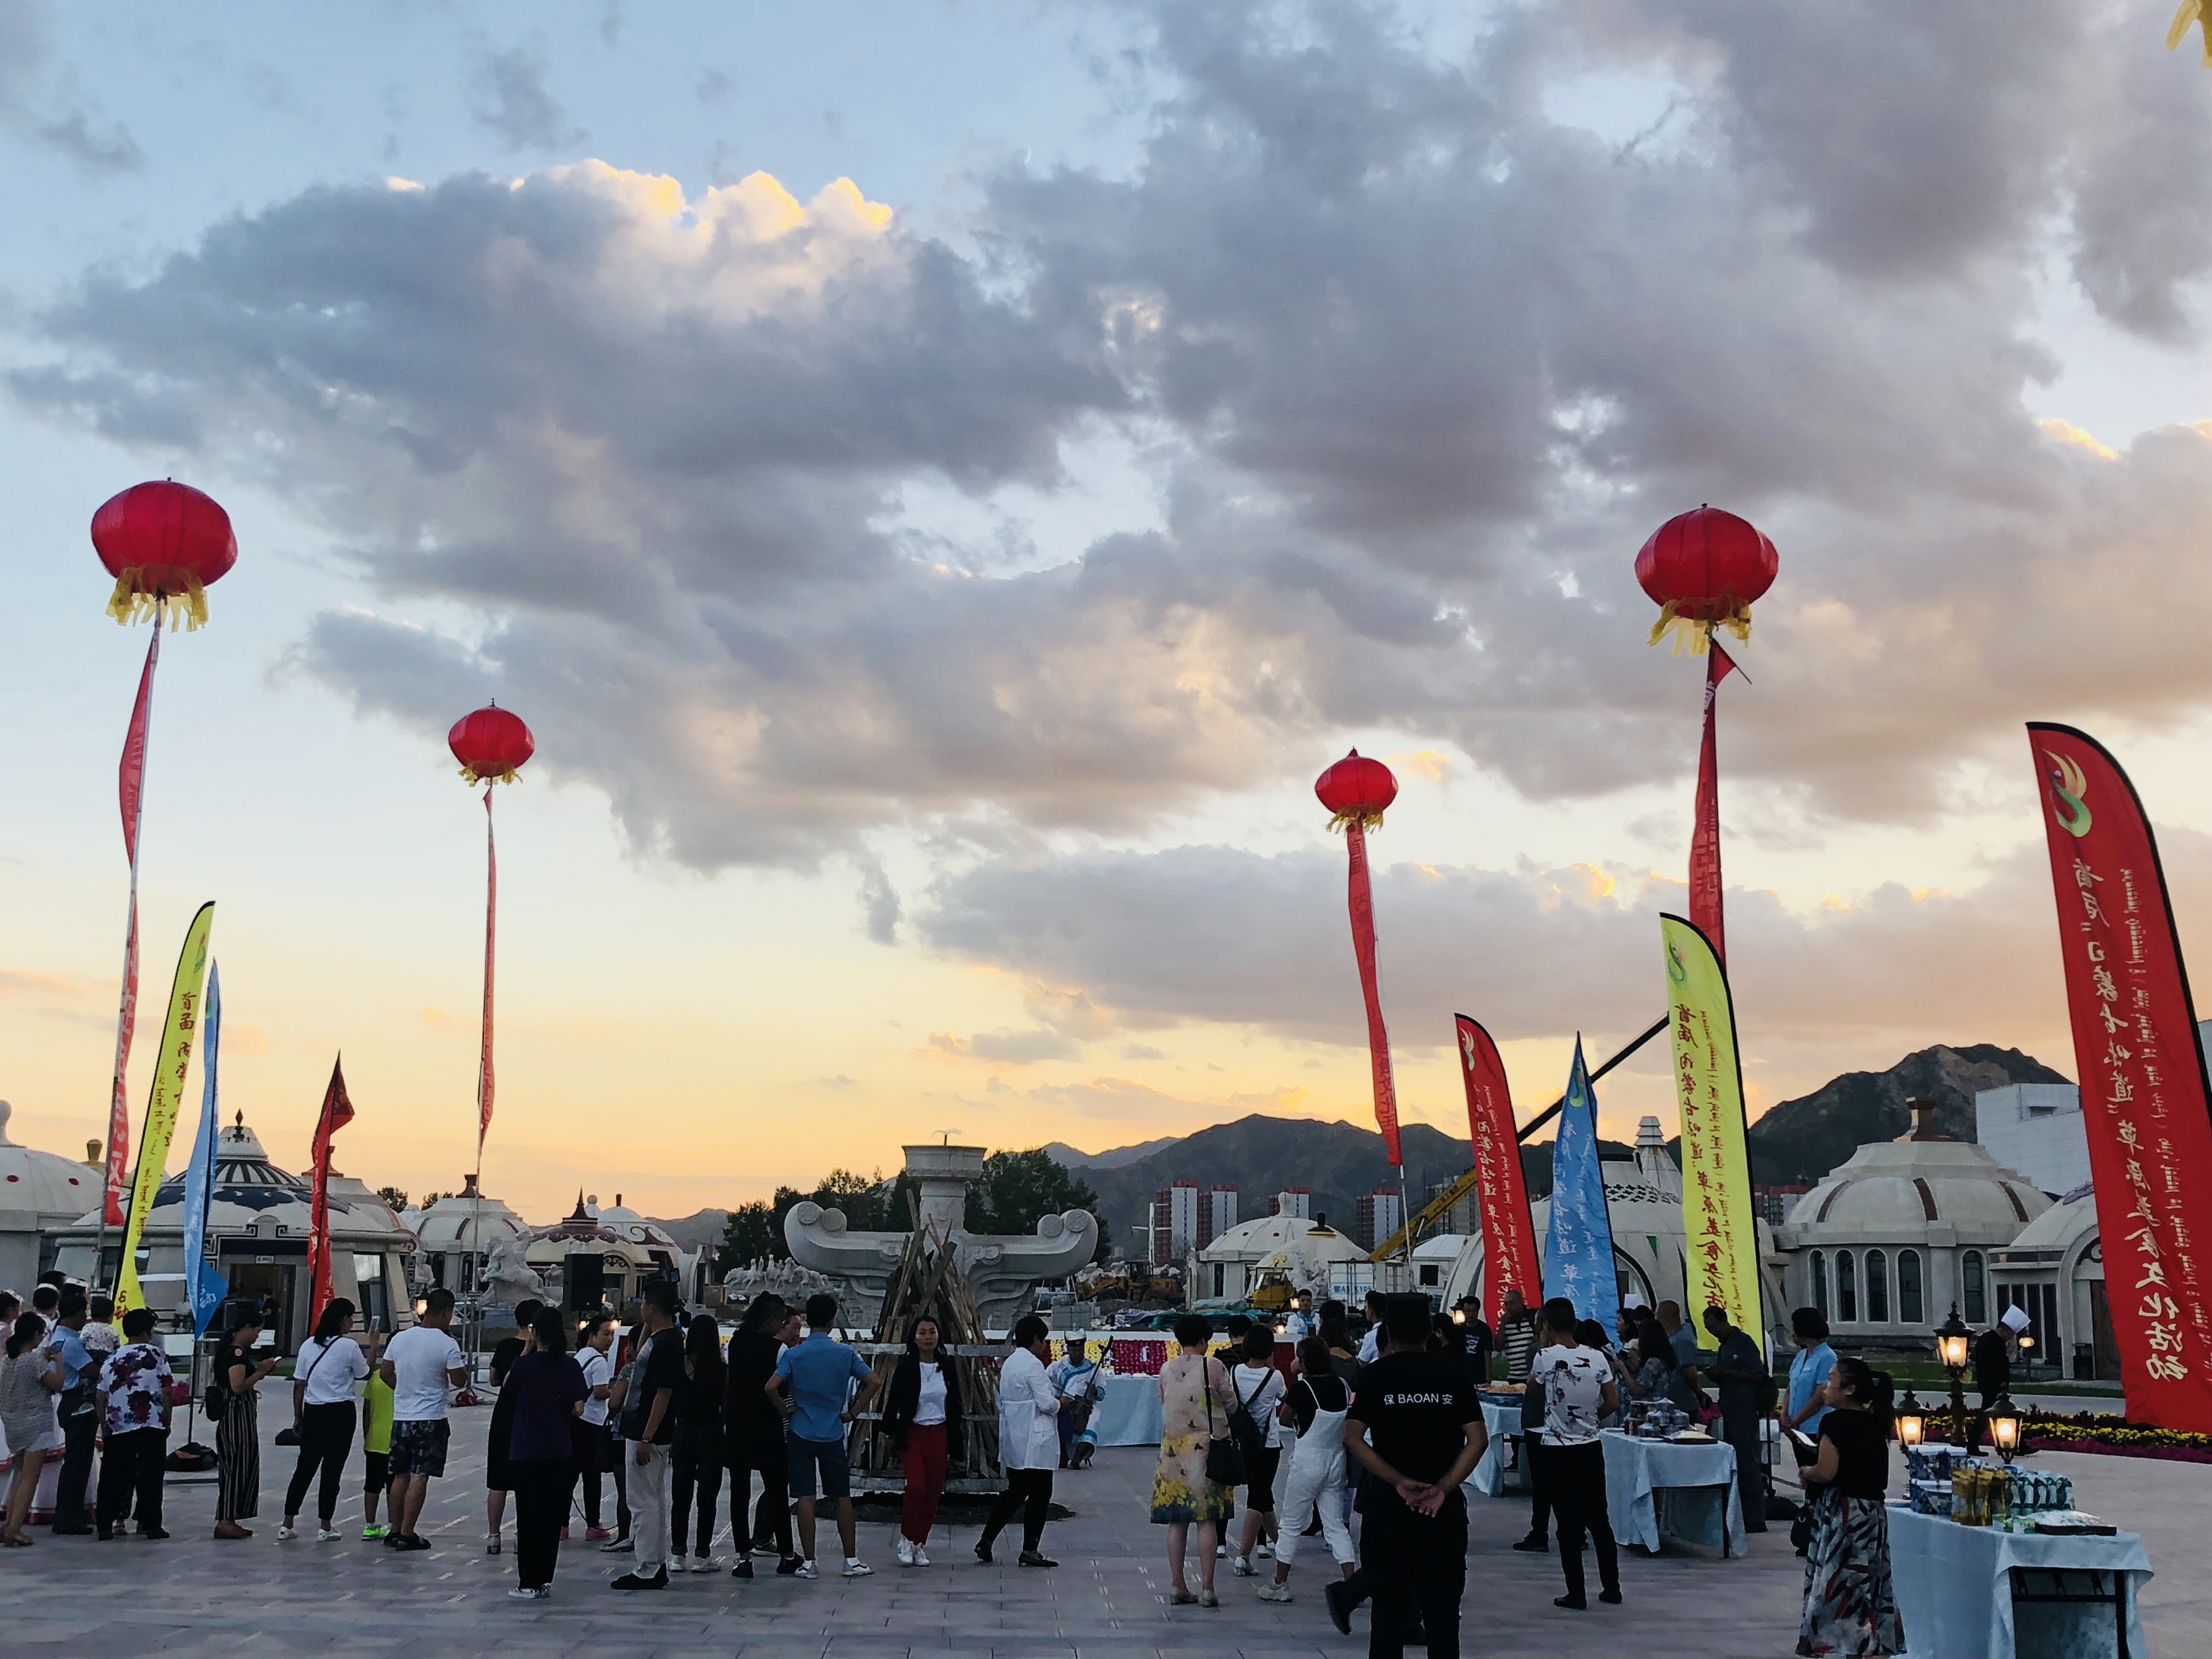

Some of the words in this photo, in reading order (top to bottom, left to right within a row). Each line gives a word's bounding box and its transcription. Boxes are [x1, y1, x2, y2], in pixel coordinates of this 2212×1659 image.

[1384, 1394, 1395, 1406] 保
[1398, 1393, 1439, 1403] BAOAN
[1442, 1394, 1453, 1404] 安
